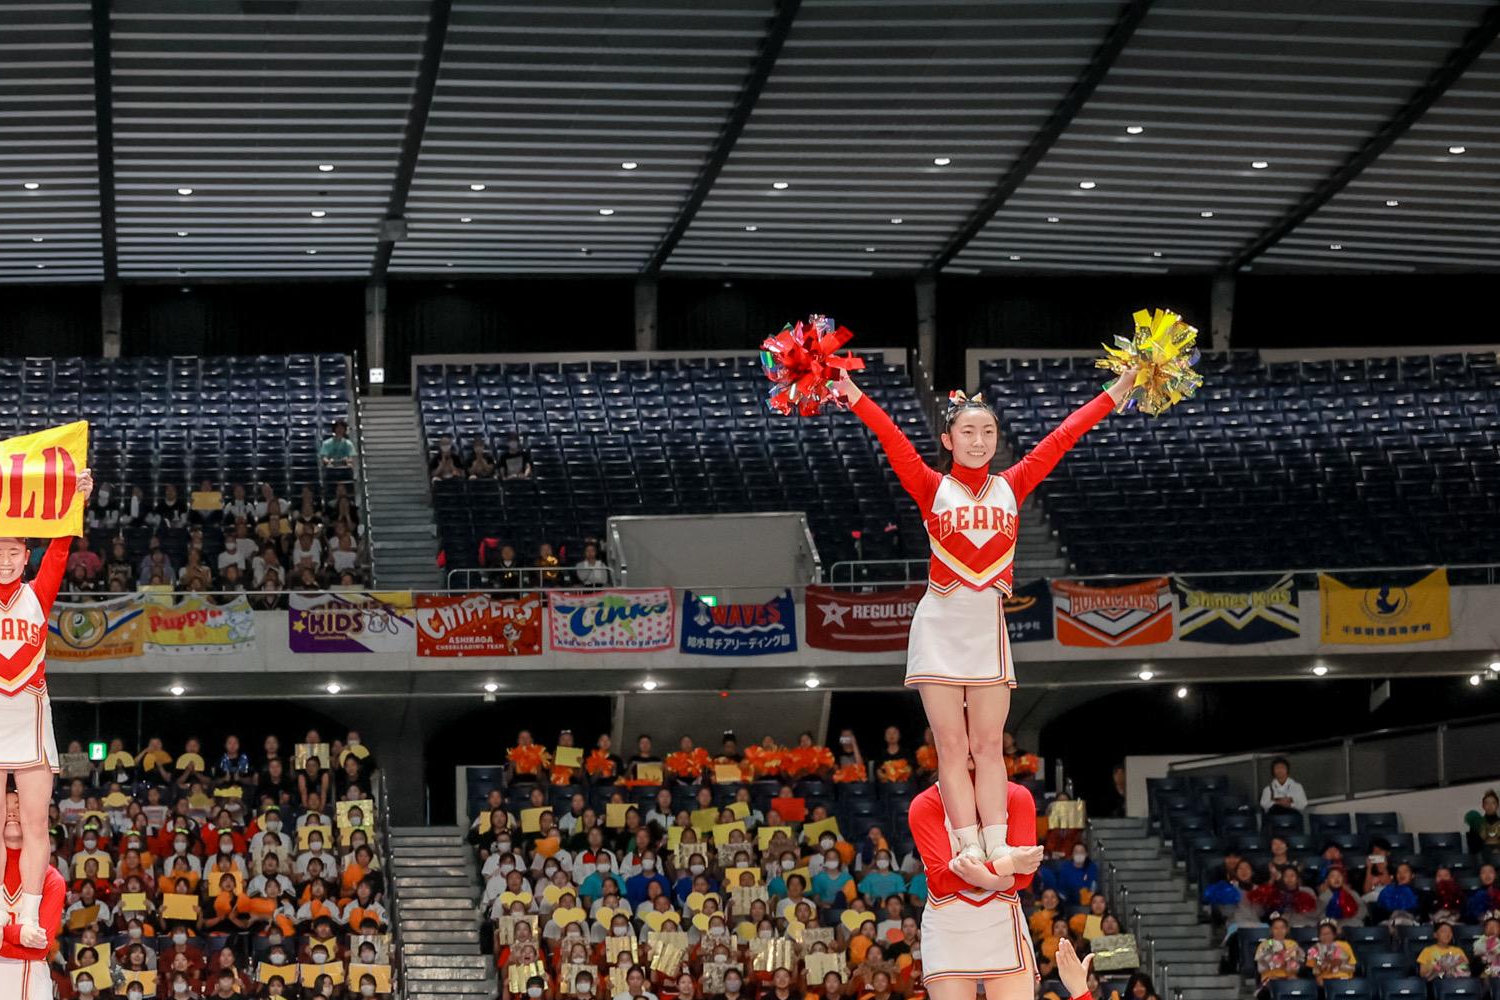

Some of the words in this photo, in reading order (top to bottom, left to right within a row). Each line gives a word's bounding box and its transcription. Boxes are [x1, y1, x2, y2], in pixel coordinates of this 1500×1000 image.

[940, 505, 1016, 541] BEARS
[710, 604, 781, 626] WAVES
[852, 602, 917, 619] REGULUS
[1070, 591, 1159, 616] HURRICANES
[308, 610, 365, 634] KIDS
[416, 595, 540, 639] CHIPPERS
